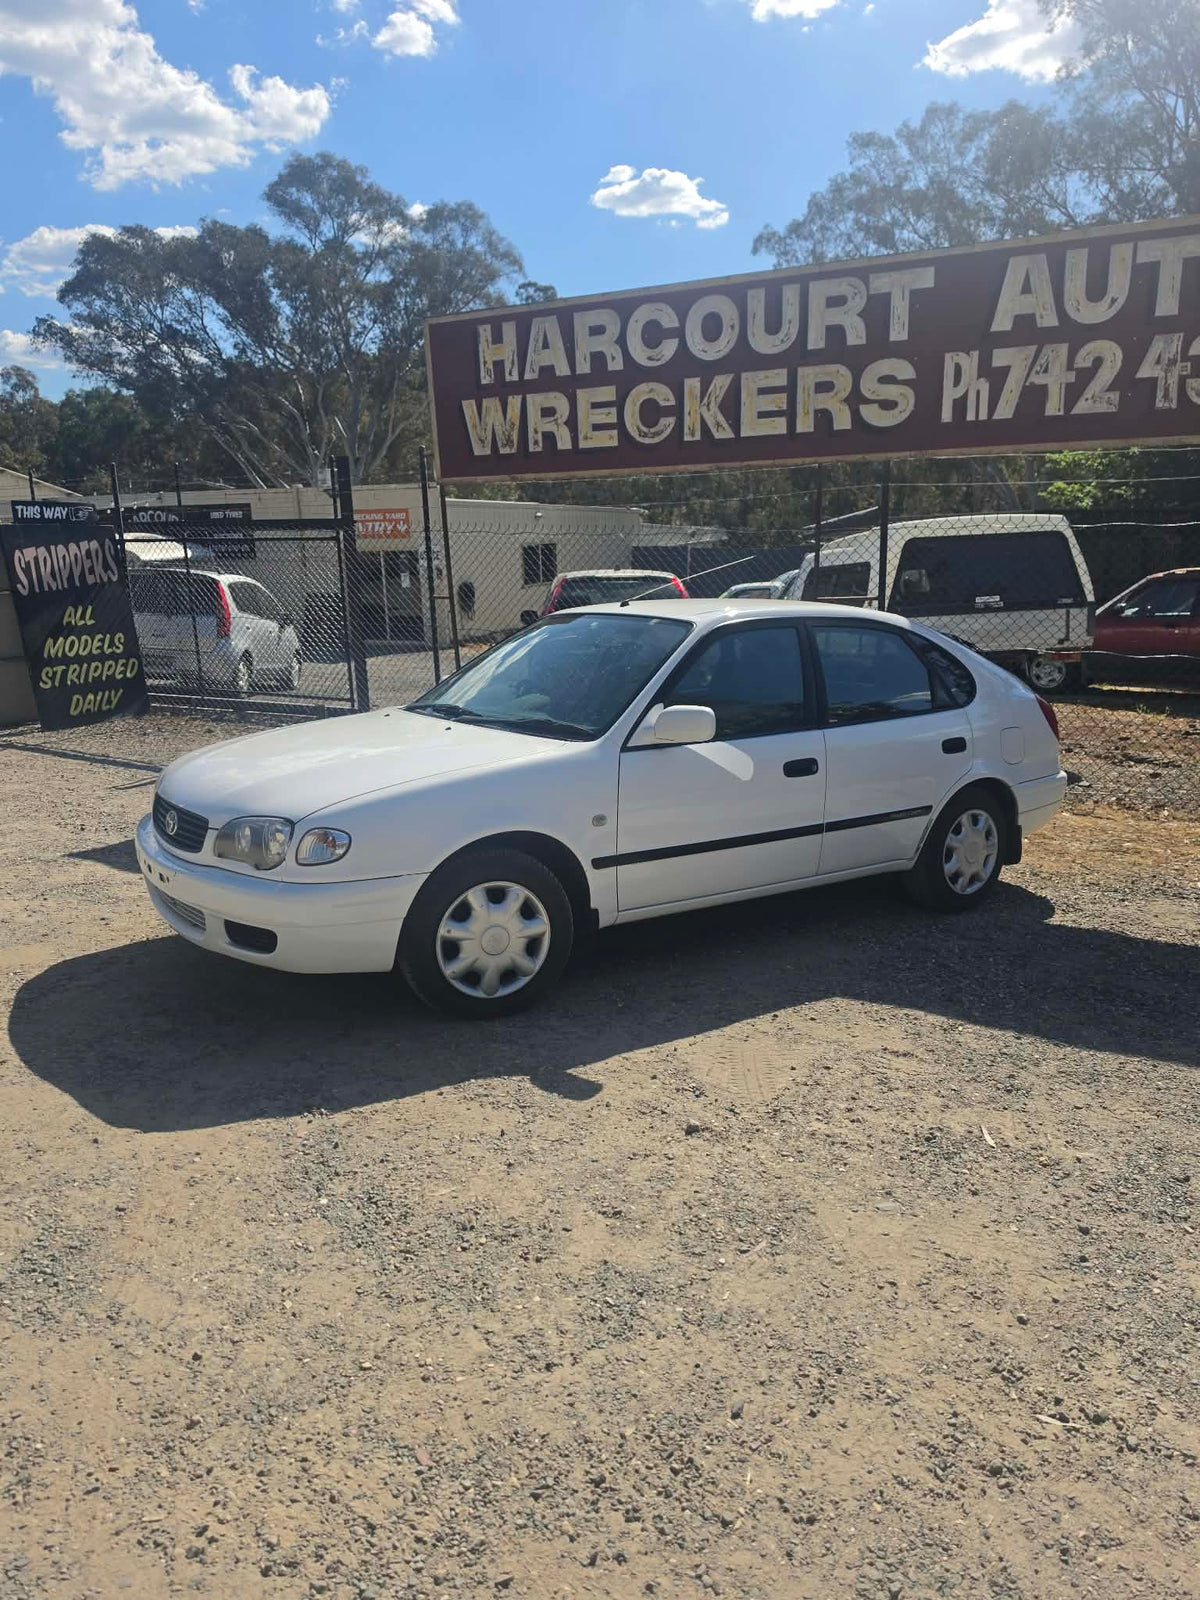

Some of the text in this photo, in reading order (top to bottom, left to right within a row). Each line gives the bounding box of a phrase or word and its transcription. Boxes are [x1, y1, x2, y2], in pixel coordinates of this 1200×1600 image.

[477, 234, 1200, 385] HARCOURT AUT
[461, 357, 917, 456] WRECKERS
[15, 505, 68, 520] THIS WAY
[13, 538, 118, 596] STRIPPERS
[62, 605, 96, 626] ALL
[43, 632, 125, 658] MODELS
[39, 658, 139, 689] STRIPPED
[69, 688, 123, 716] DAILY
